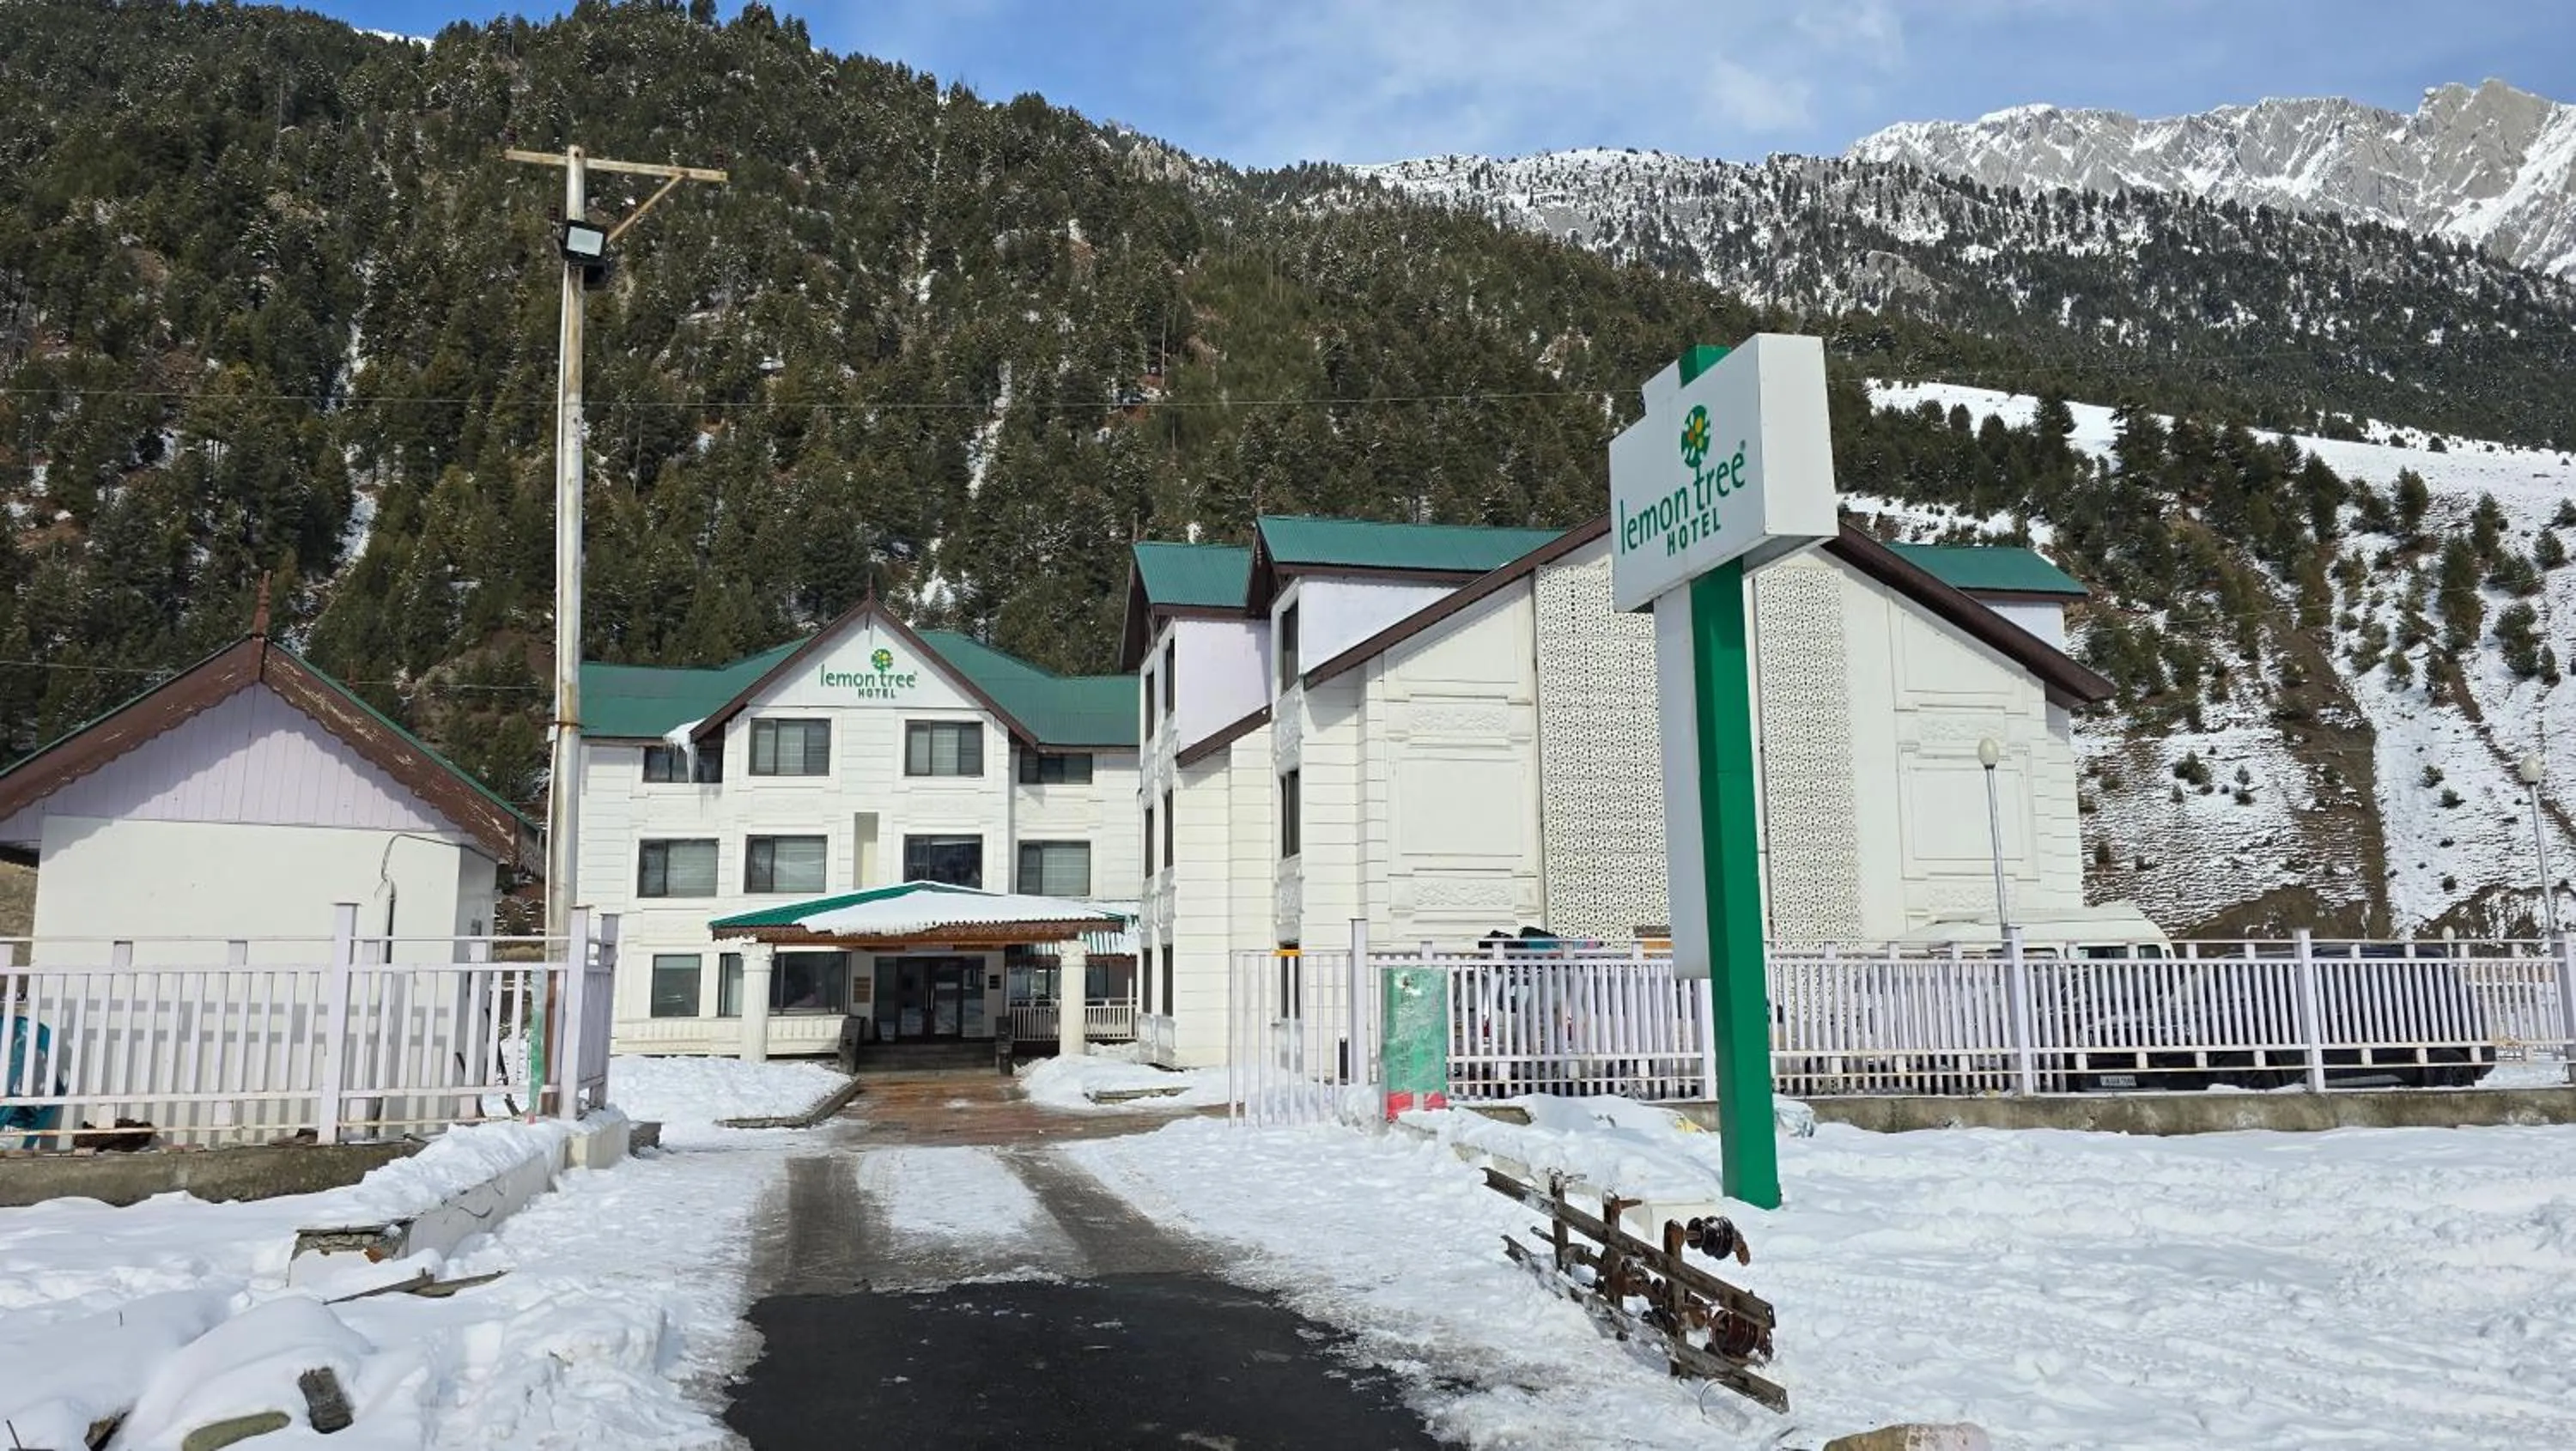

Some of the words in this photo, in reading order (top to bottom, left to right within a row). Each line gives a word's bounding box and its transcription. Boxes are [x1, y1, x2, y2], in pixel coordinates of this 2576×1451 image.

[1620, 487, 1688, 555] lemon
[1693, 452, 1746, 513] tree
[1667, 507, 1721, 557] HOTEL
[820, 664, 875, 688] lemon
[879, 671, 916, 688] tree
[858, 689, 896, 699] HOTEL
